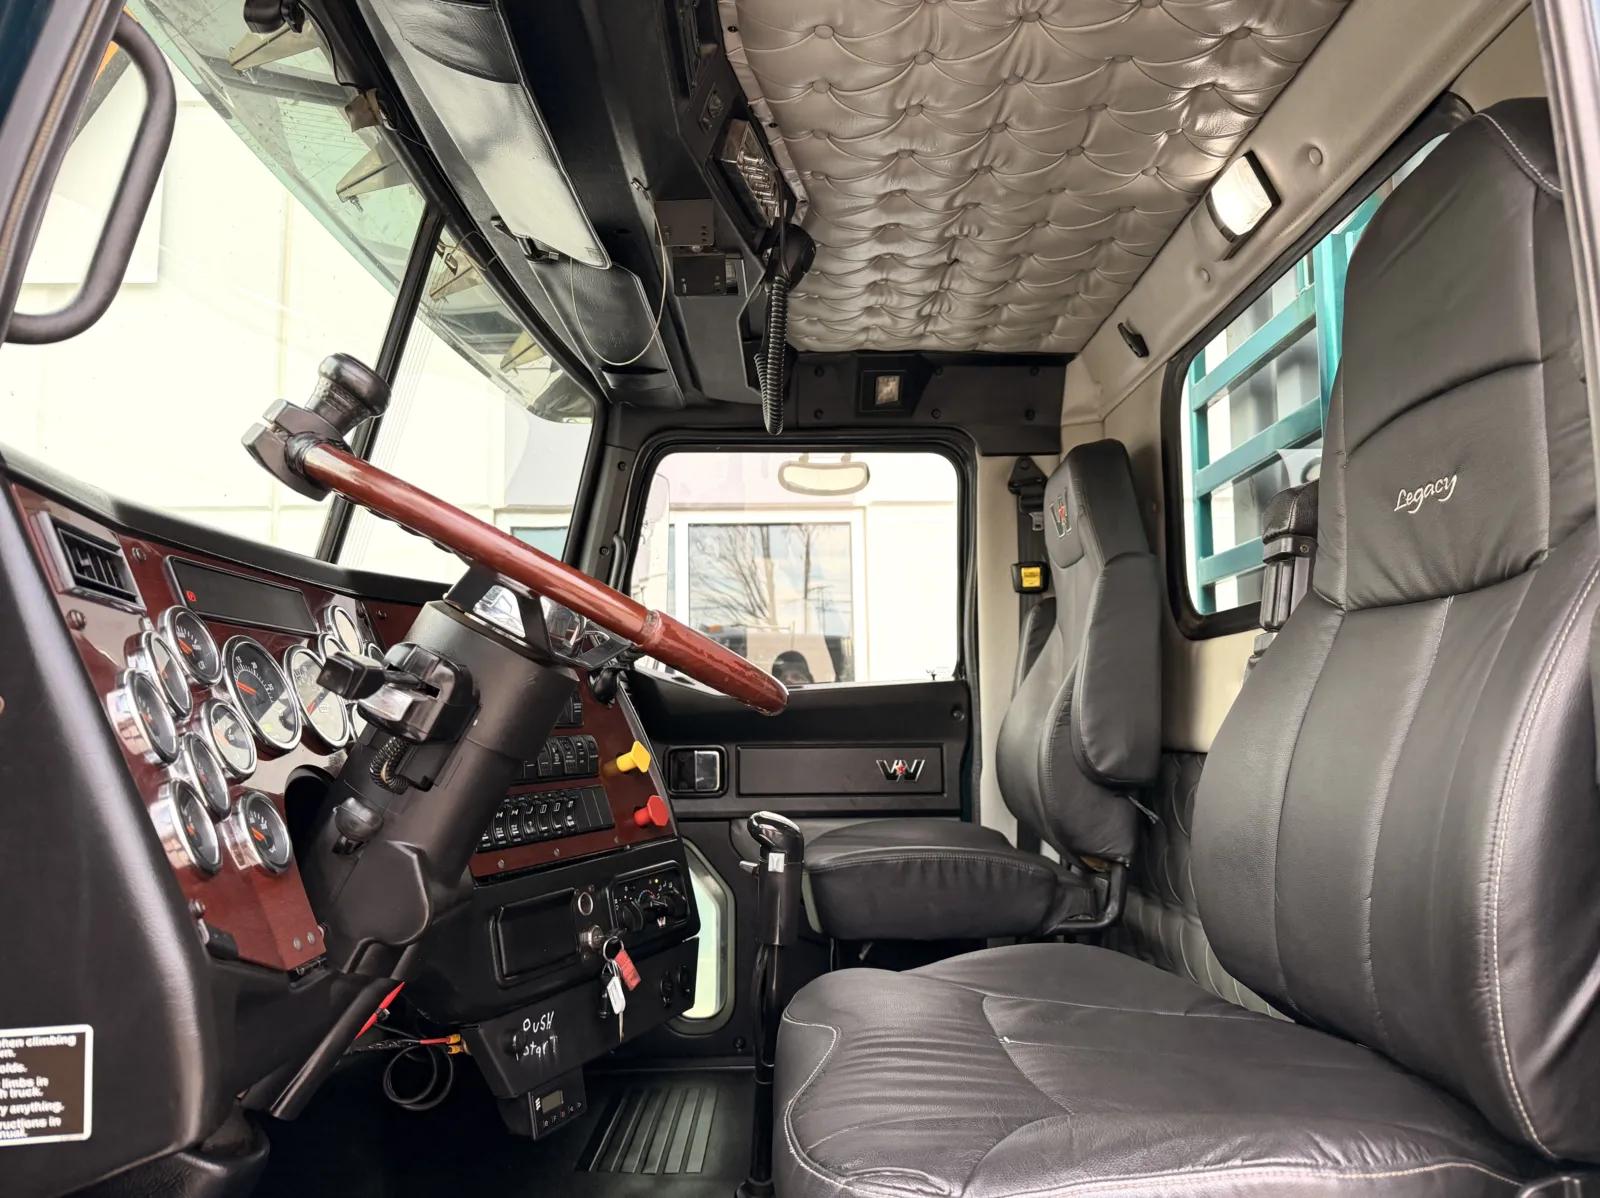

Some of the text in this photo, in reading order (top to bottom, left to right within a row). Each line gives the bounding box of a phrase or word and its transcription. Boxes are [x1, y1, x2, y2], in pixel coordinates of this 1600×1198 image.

[1393, 474, 1458, 514] Legacy
[0, 1034, 77, 1049] hen climbing
[2, 1075, 49, 1089] limbs in
[48, 1115, 62, 1127] in
